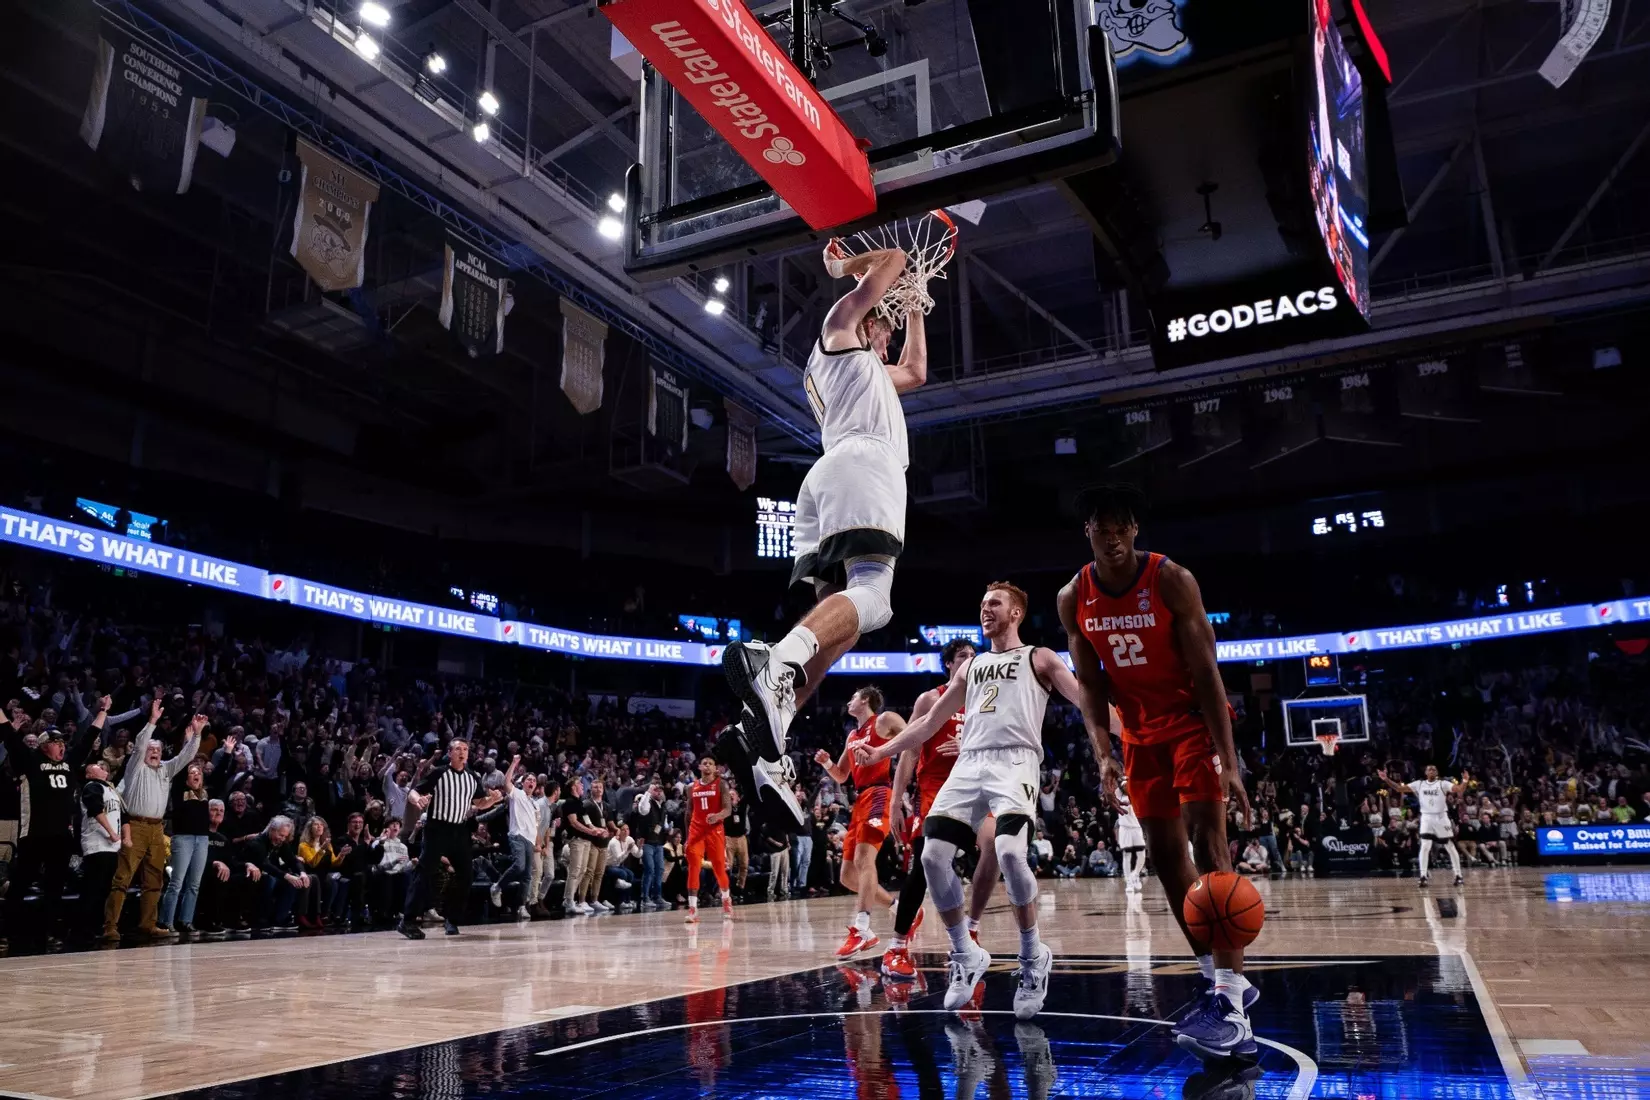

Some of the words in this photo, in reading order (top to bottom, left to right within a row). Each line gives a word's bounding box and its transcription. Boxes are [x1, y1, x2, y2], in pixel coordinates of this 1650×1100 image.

[129, 41, 180, 81] SOUTHERN
[122, 53, 183, 97] CONFERENCE
[124, 69, 177, 108] CHAMPIONS
[467, 252, 487, 274] NCAA
[455, 259, 498, 290] APPEARANCES
[1167, 286, 1338, 342] #GODEACS
[1416, 359, 1448, 377] 1996
[1340, 373, 1370, 391] 1984
[1263, 387, 1293, 404] 1962
[1193, 398, 1220, 415] 1977
[1124, 410, 1151, 426] 1961
[1, 512, 96, 553] THAT'S
[101, 535, 173, 571] WHAT
[177, 554, 185, 574] I
[303, 584, 365, 614] THAT'S
[368, 598, 425, 624] WHAT
[428, 610, 434, 626] I
[1084, 612, 1157, 632] CLEMSON
[1375, 626, 1443, 647] THAT'S
[1446, 619, 1504, 640] WHAT
[1507, 616, 1515, 633] I
[528, 627, 580, 651] THAT'S
[582, 636, 632, 656] WHAT
[635, 642, 642, 657] I
[1107, 633, 1148, 668] 22
[1216, 642, 1265, 660] WHAT
[1267, 640, 1274, 656] I
[840, 656, 847, 670] I
[973, 662, 1020, 685] WAKE
[979, 683, 999, 714] 2
[48, 773, 69, 789] 10
[692, 790, 716, 798] CLEMSON
[700, 796, 709, 810] 11
[1572, 841, 1607, 851] Raised
[1608, 840, 1623, 850] for
[1576, 830, 1610, 841] Over
[1326, 840, 1371, 855] Allegacy
